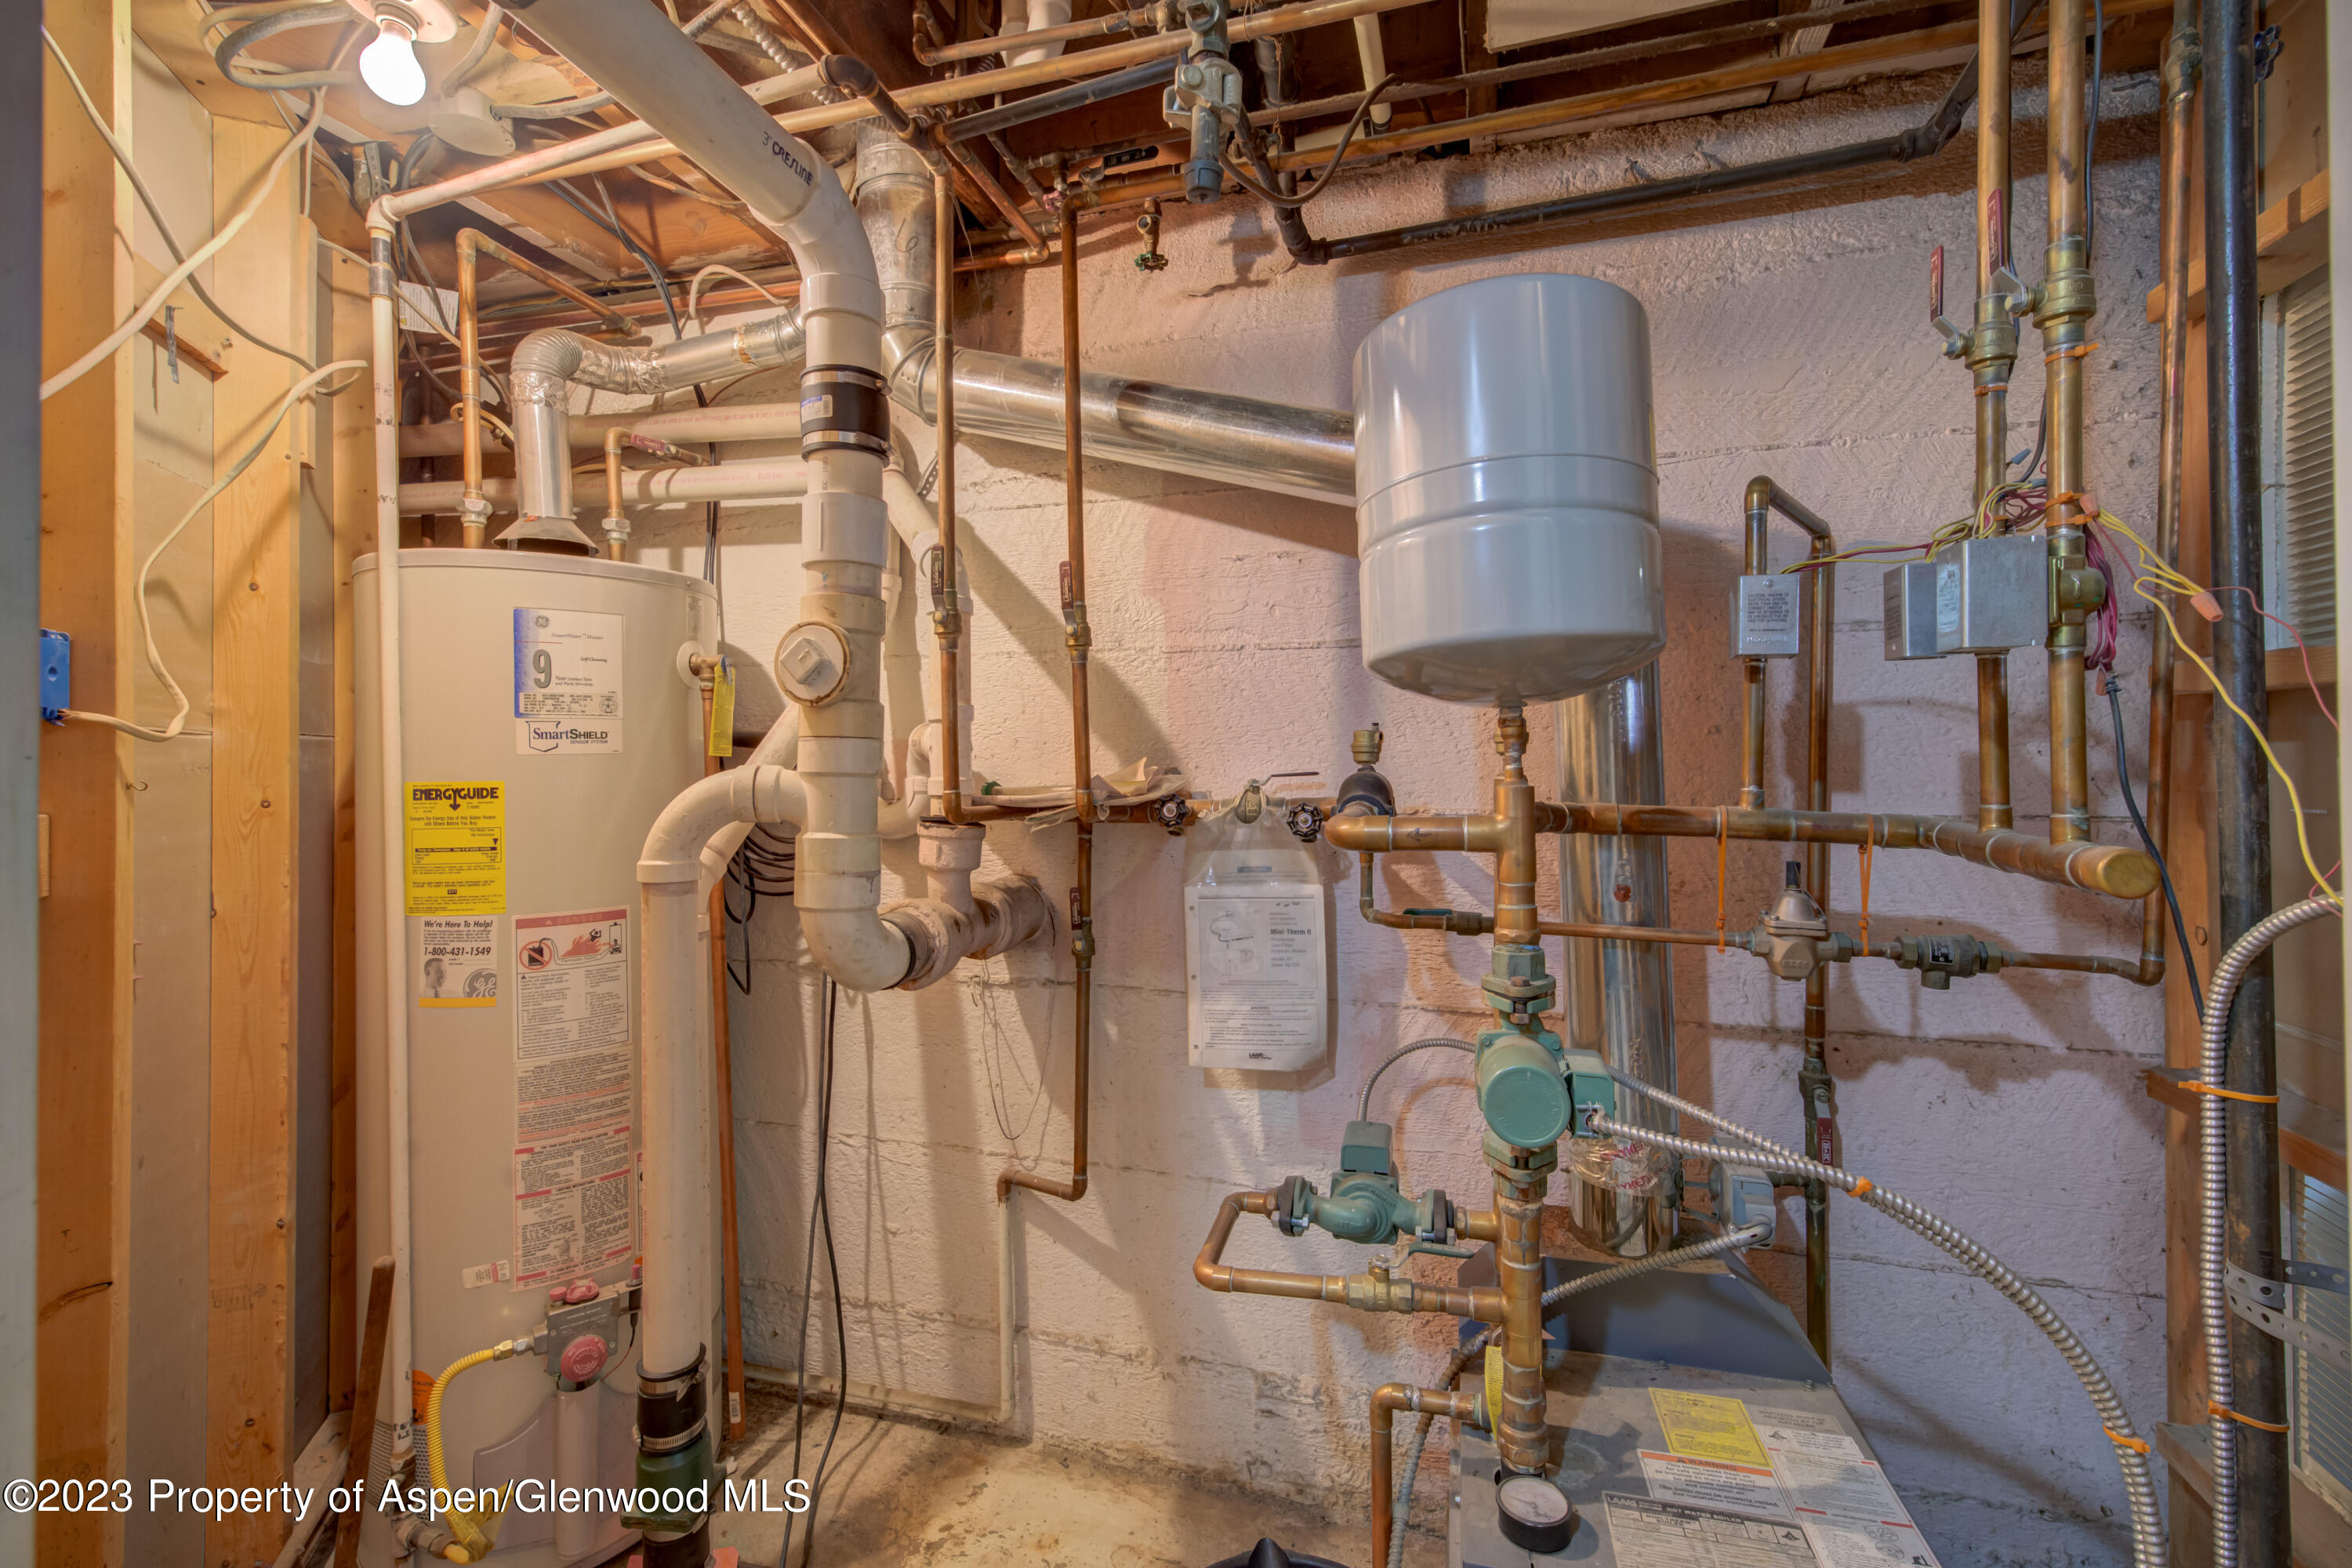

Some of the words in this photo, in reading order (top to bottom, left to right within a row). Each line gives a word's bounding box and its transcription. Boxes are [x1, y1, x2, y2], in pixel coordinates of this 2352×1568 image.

[771, 140, 814, 187] CRESLINE
[533, 648, 552, 689] 9
[412, 787, 499, 801] ENERGYGUIDE
[424, 920, 443, 928] We're
[474, 920, 493, 929] Help!
[424, 946, 492, 956] 1-800-431-1549
[1686, 1458, 1737, 1472] WARNING
[1683, 1510, 1711, 1519] WATER
[1713, 1514, 1742, 1523] BOILER
